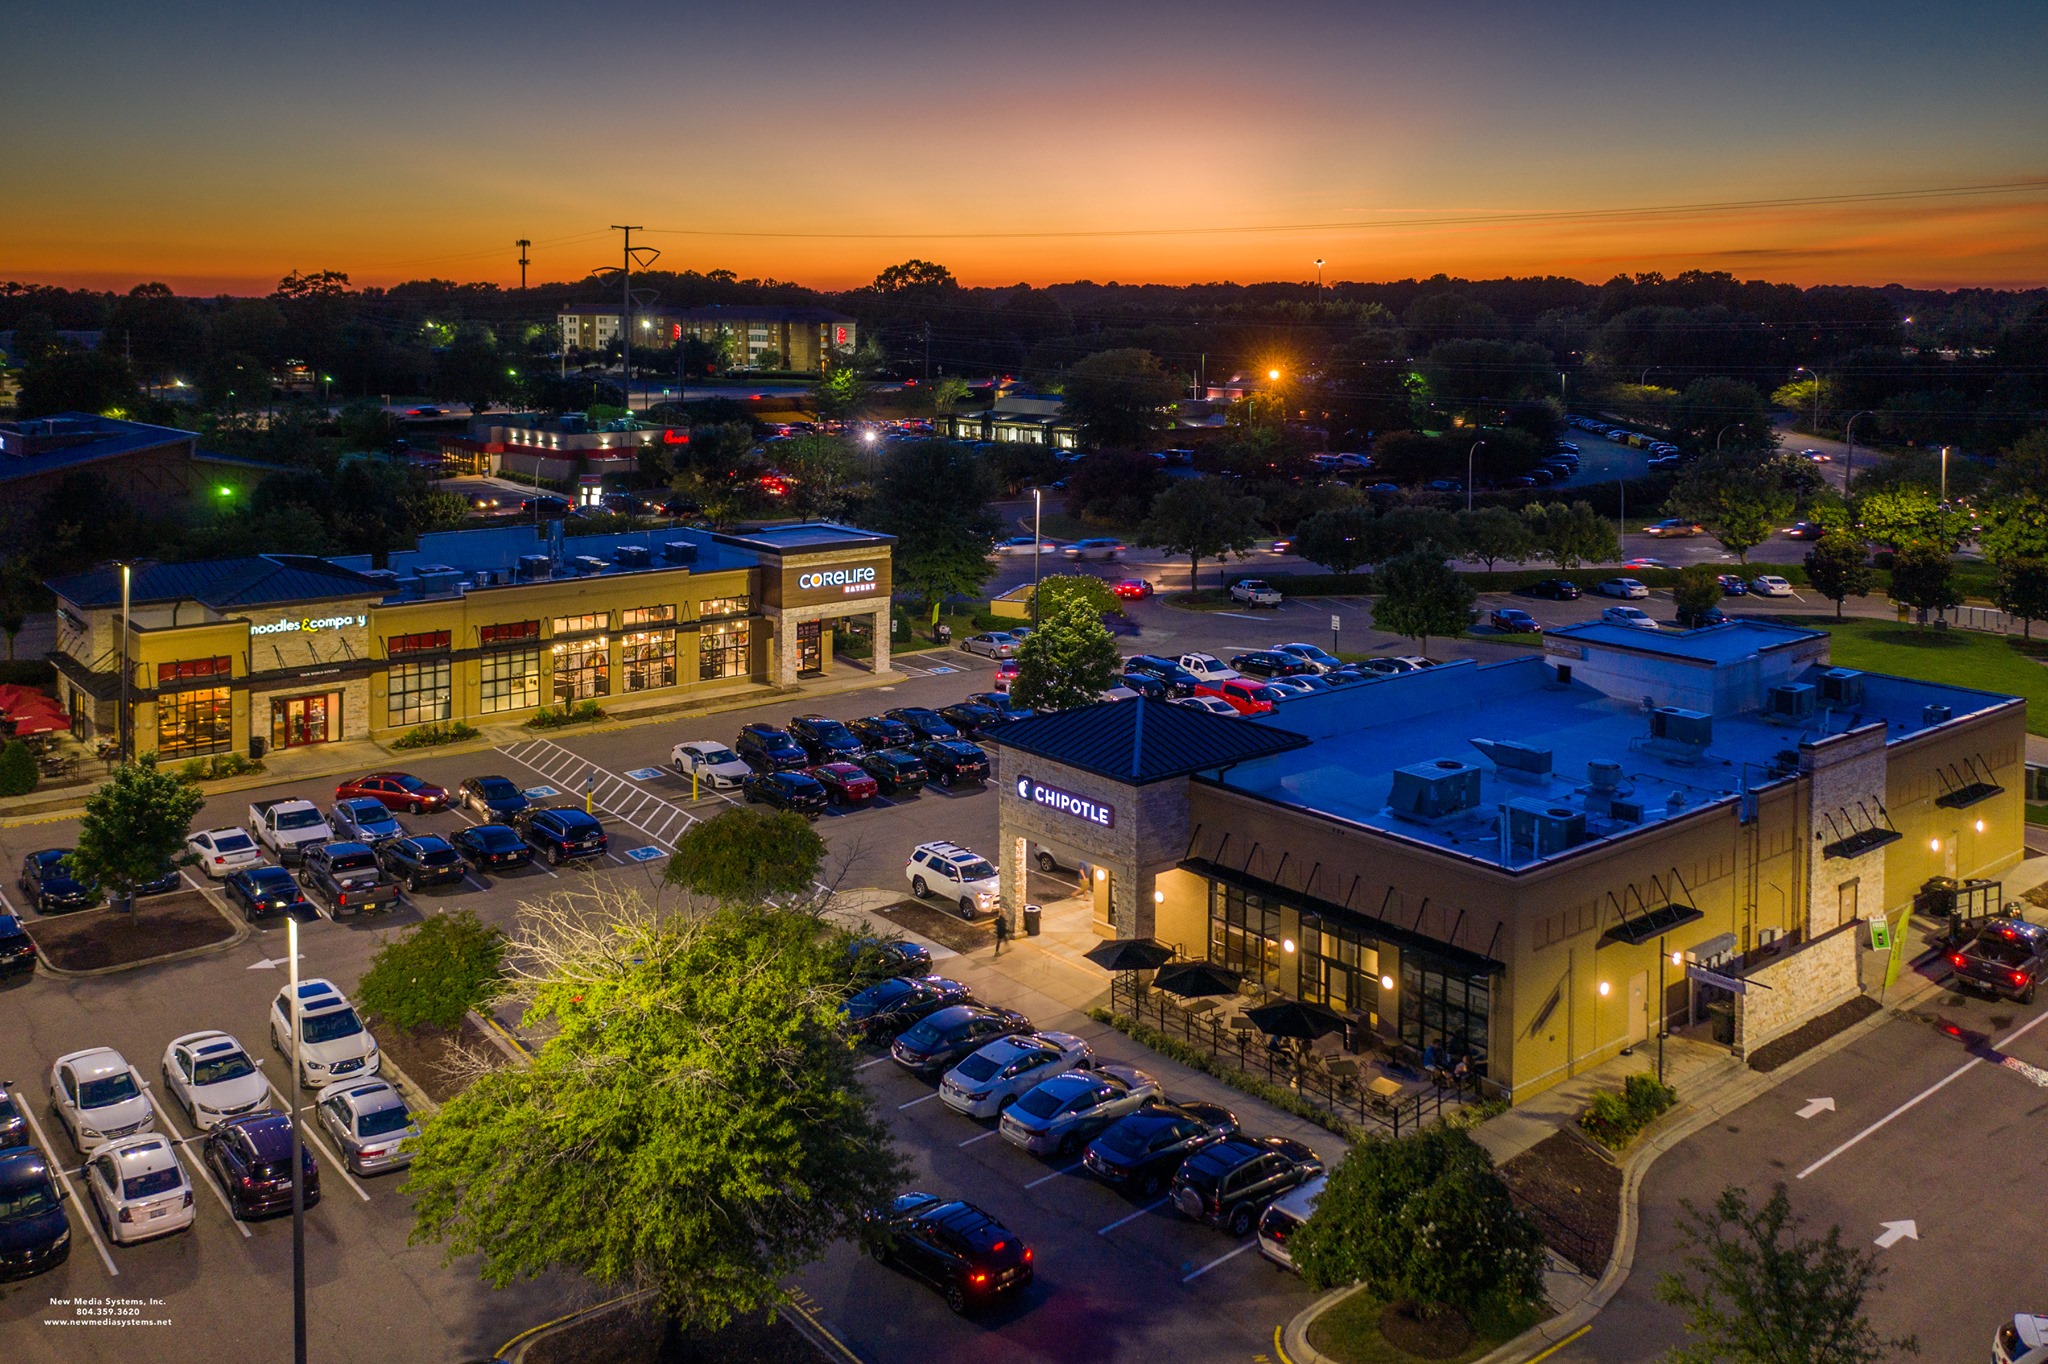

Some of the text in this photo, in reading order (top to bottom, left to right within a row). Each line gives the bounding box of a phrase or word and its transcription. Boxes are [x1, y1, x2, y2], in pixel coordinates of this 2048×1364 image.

[844, 583, 876, 593] EATERY
[251, 619, 301, 635] noodles
[309, 615, 367, 629] compay
[1035, 786, 1109, 824] CHIPOTLE
